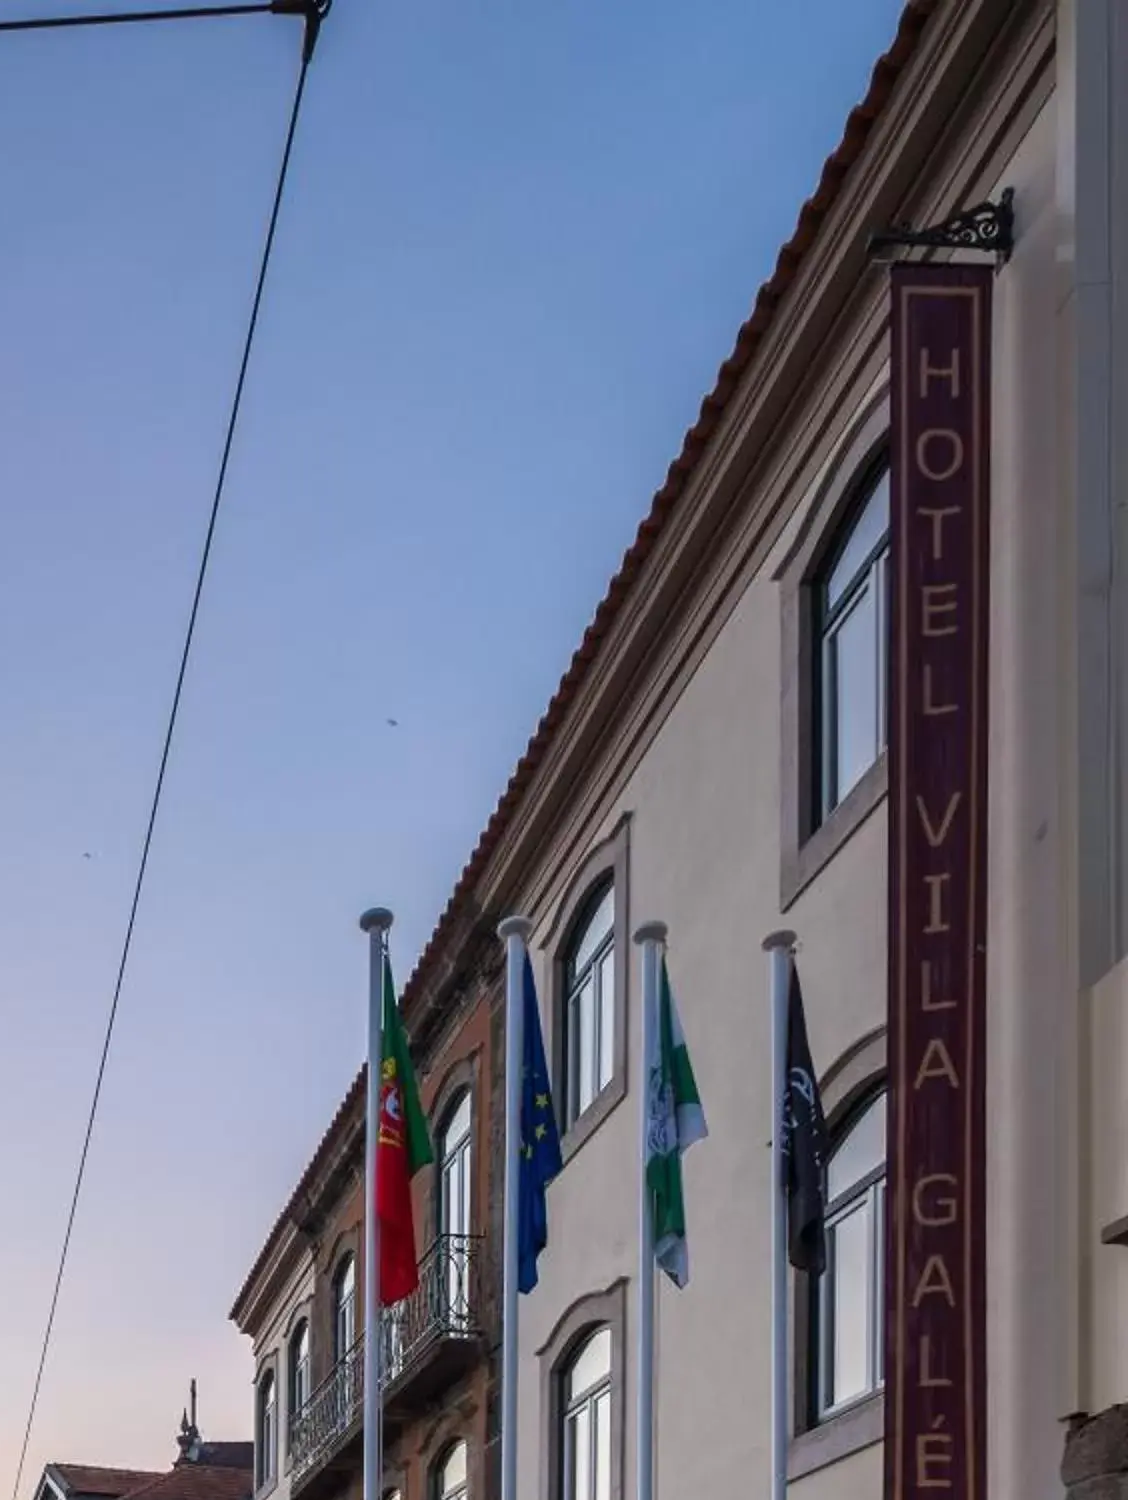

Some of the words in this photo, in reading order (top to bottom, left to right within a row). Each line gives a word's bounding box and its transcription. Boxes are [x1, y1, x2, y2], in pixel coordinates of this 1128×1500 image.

[916, 347, 964, 715] HOTEL
[915, 793, 959, 1090] VILA
[912, 1172, 957, 1489] GALÉ
